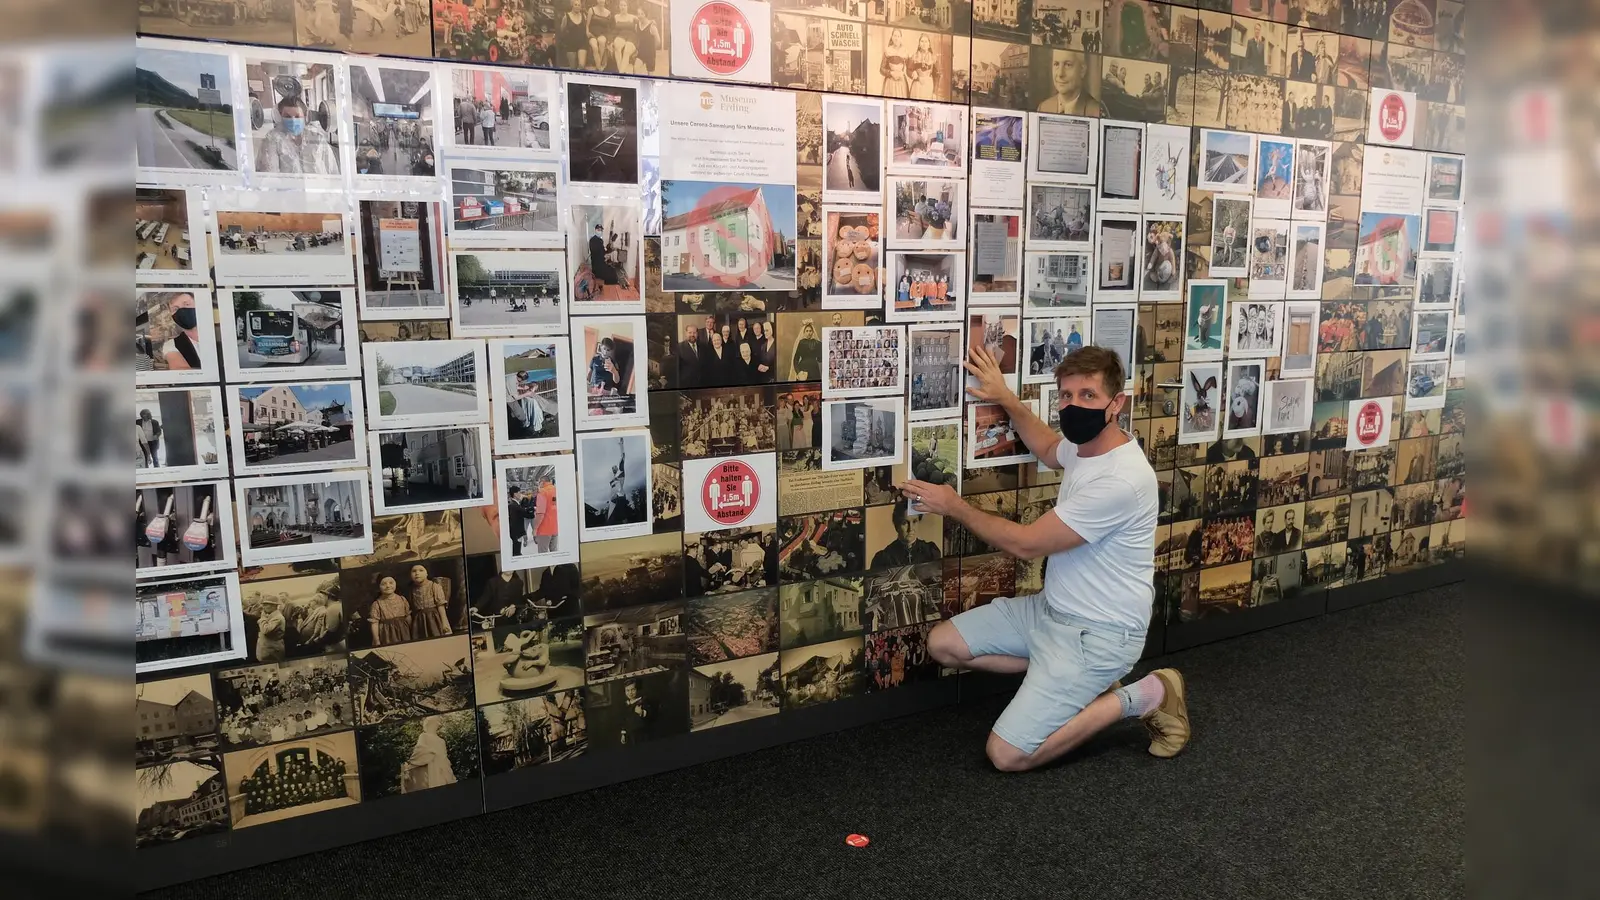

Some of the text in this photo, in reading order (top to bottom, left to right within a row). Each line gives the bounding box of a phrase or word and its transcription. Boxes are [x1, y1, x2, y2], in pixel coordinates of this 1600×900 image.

[836, 24, 854, 32] AUTO
[830, 31, 860, 39] SCHNELL
[713, 39, 731, 49] 1,5m
[720, 94, 757, 104] Museum
[720, 102, 750, 113] Erding
[690, 121, 735, 130] Corona-Sammlung
[723, 465, 739, 473] Bitte
[726, 484, 737, 492] Sie
[722, 493, 740, 502] 1,5m
[717, 509, 746, 518] Abstand.
